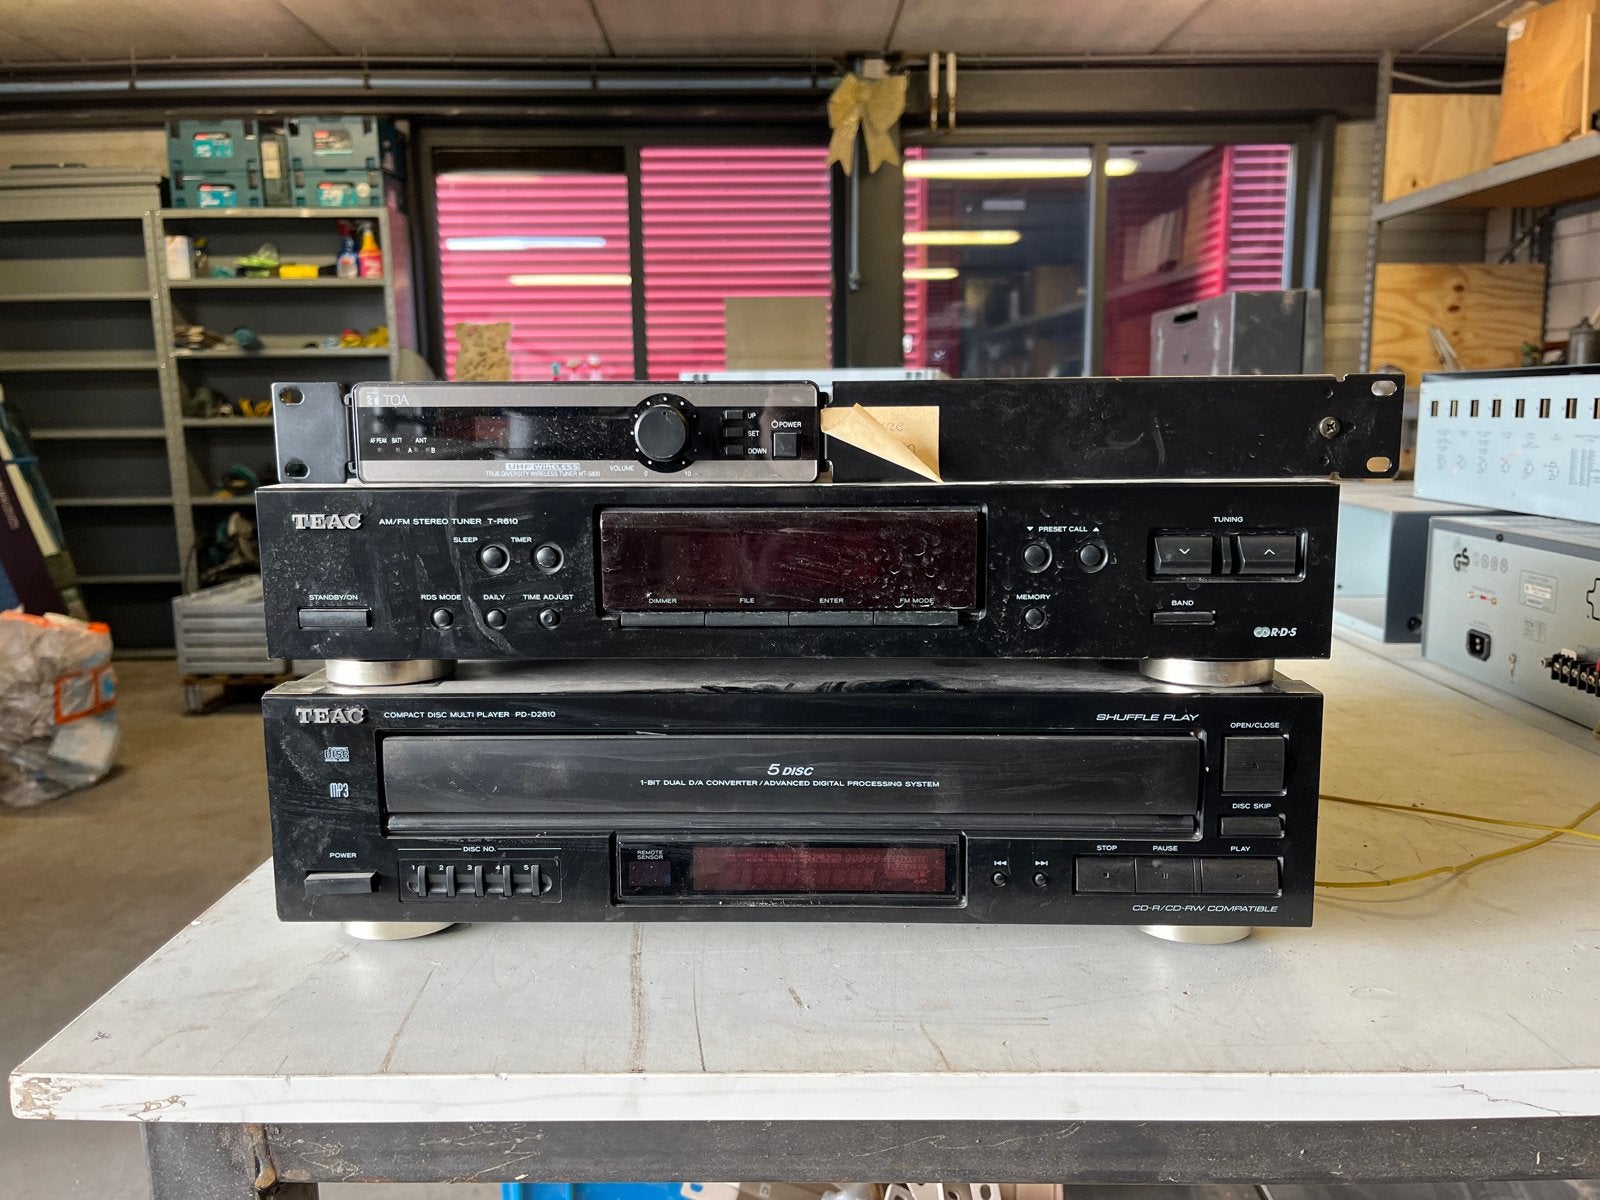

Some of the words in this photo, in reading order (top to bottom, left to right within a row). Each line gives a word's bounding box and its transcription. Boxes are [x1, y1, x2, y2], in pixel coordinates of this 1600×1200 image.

[383, 394, 410, 407] TOA
[291, 513, 361, 529] TEAC
[295, 707, 364, 724] TEAC
[767, 764, 780, 775] 5
[782, 767, 814, 776] DISC
[330, 783, 349, 798] MP3
